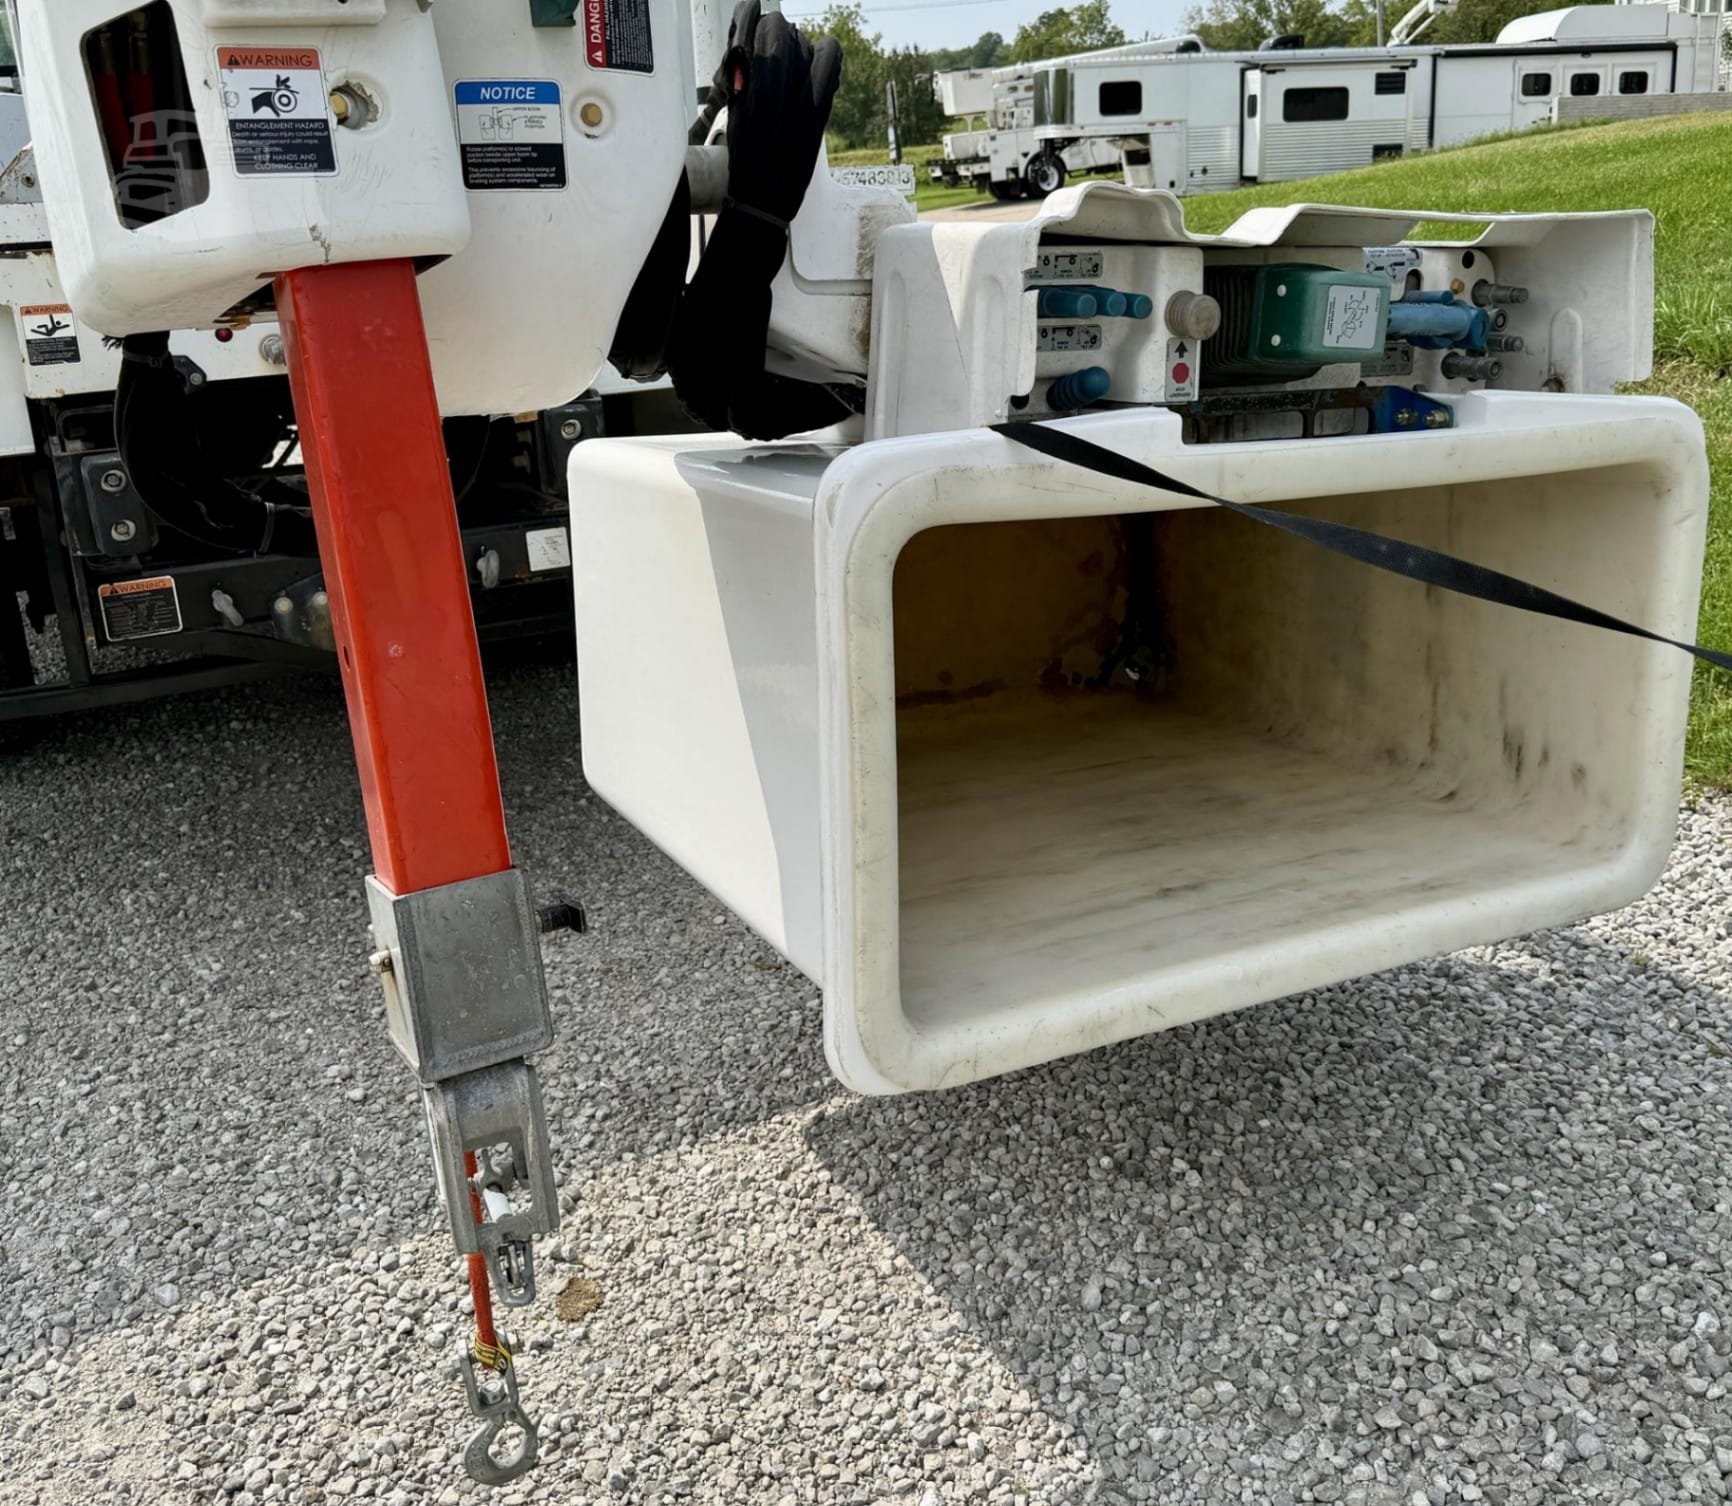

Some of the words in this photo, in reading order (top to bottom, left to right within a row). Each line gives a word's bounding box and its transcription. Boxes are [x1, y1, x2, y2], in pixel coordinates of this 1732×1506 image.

[588, 0, 602, 43] DANG
[240, 54, 313, 66] WARNING
[480, 86, 536, 100] NOTICE
[120, 581, 167, 592] WARNING
